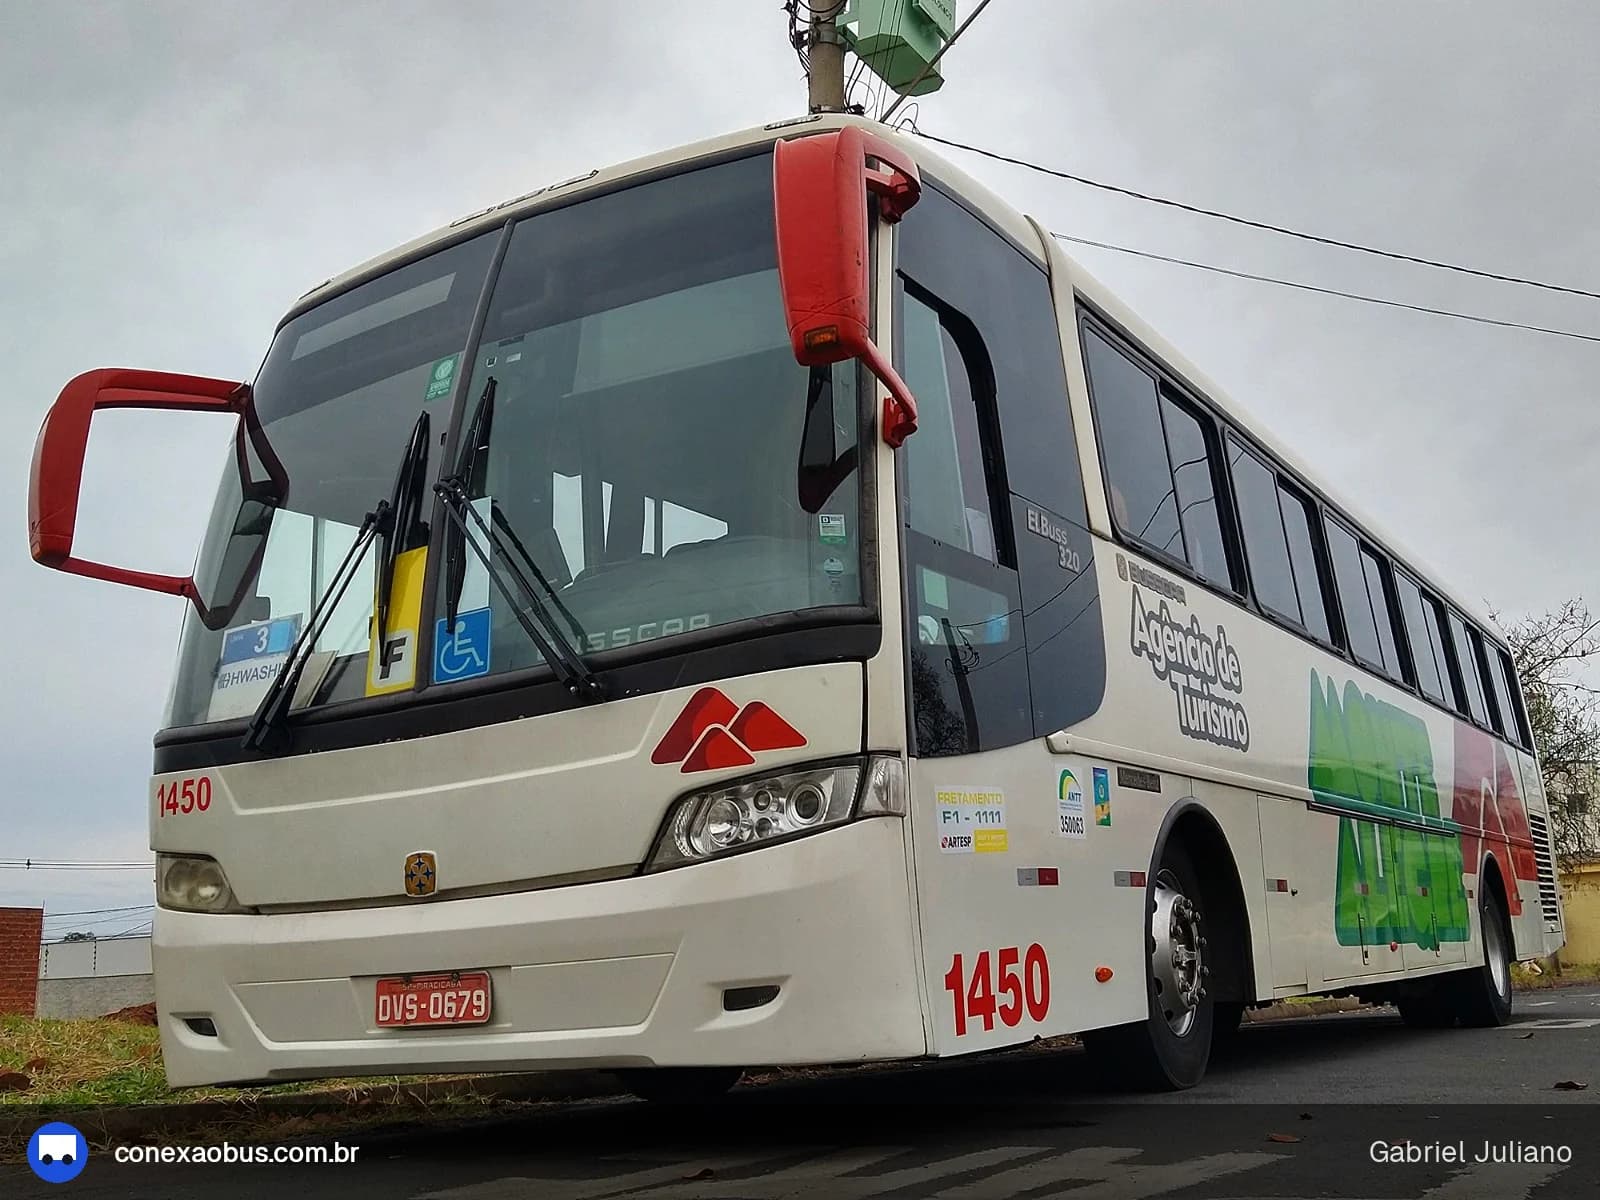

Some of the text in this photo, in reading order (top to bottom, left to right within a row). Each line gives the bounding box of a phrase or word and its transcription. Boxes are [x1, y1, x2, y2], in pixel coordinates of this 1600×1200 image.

[1058, 545, 1081, 573] 320
[253, 626, 269, 653] 3
[1132, 587, 1241, 690] Agência de
[379, 636, 408, 680] F
[1170, 673, 1248, 747] Turismo
[157, 776, 213, 818] 1450
[937, 791, 1003, 805] FRETAMENTO
[1067, 791, 1082, 803] ANTT
[942, 810, 960, 824] F1
[975, 810, 1001, 824] 1111
[948, 835, 972, 849] ARTESP
[944, 942, 1051, 1037] 1450
[378, 989, 486, 1022] DVS-0679
